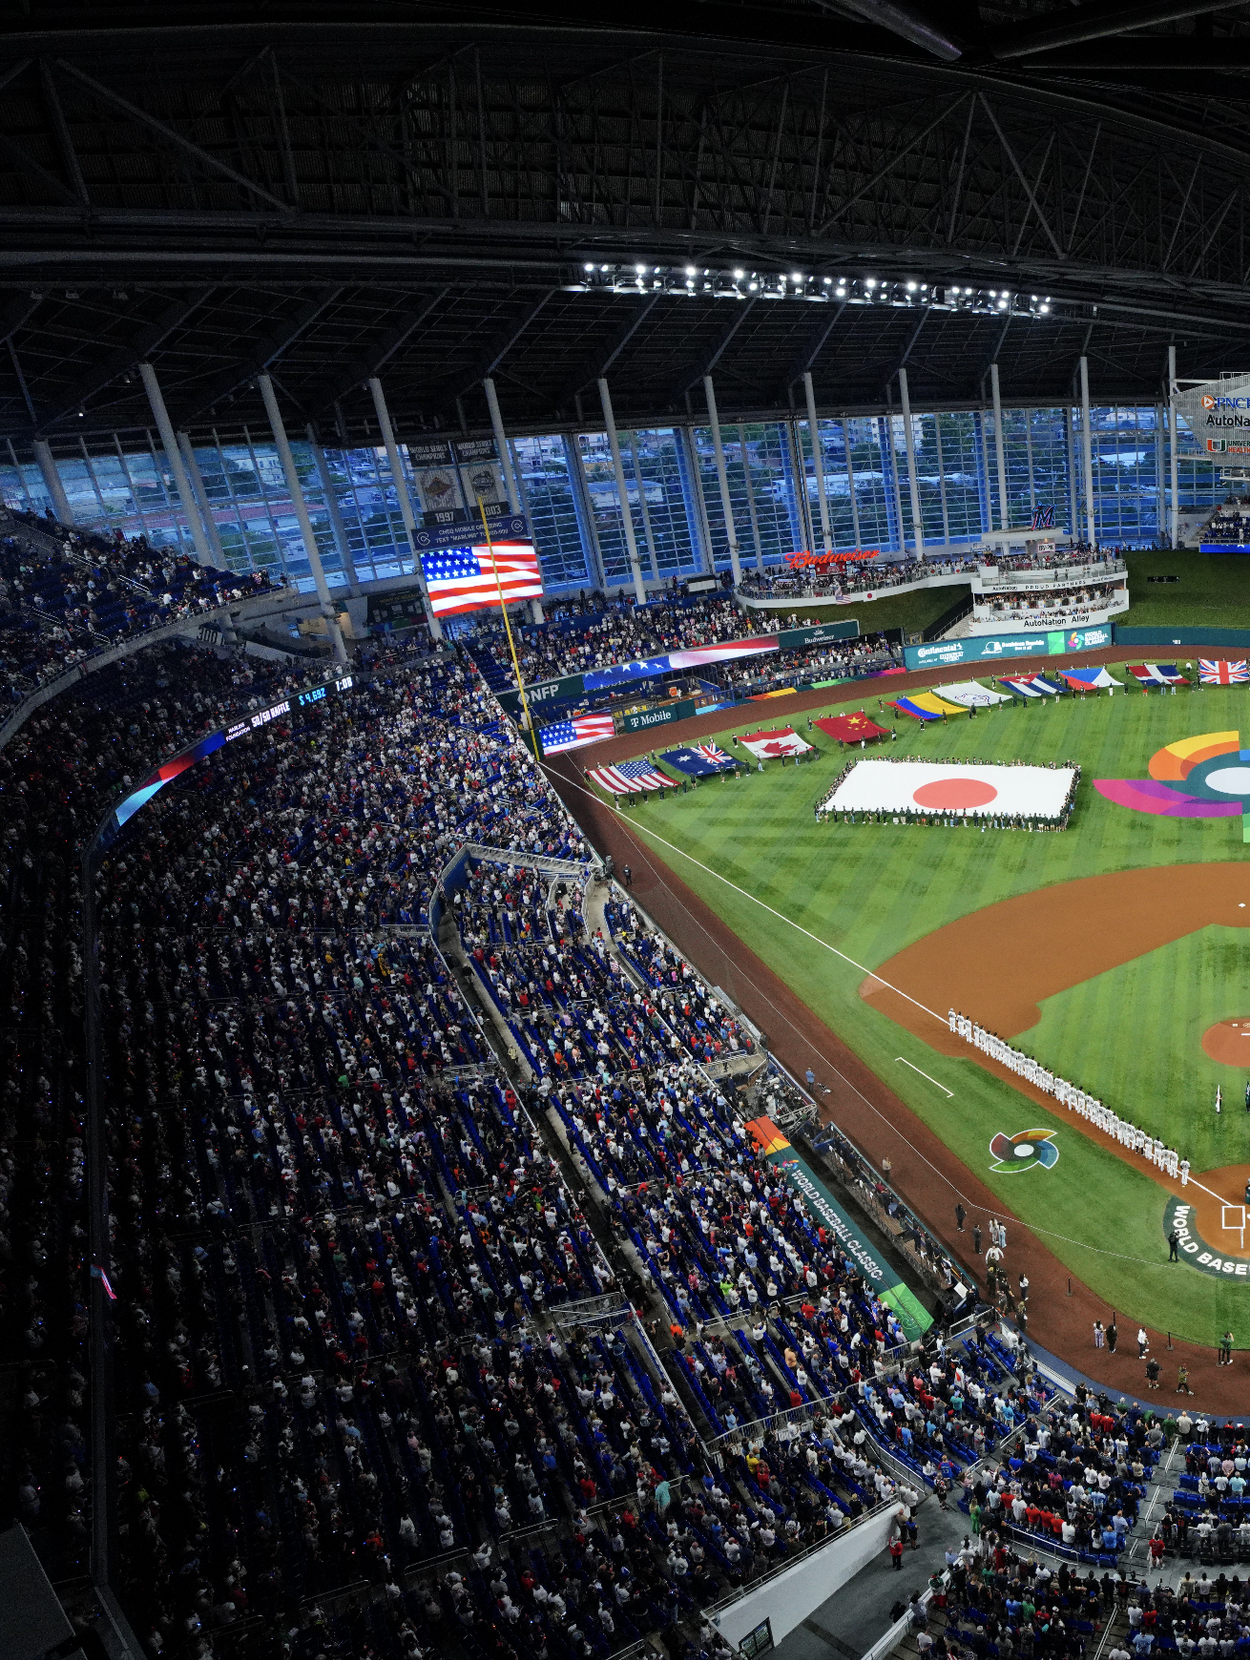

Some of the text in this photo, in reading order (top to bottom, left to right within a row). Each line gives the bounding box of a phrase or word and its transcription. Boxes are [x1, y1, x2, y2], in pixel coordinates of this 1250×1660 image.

[435, 511, 454, 522] 1997
[484, 505, 501, 515] 003
[785, 549, 879, 569] Budweiser
[1024, 614, 1089, 628] AutoNation Alley
[804, 634, 834, 643] Budweiser
[918, 644, 957, 657] Continental
[530, 685, 558, 702] NFP
[270, 701, 290, 718] RAFFLE
[641, 711, 671, 726] Mobile
[791, 1169, 884, 1280] WORLD BASEBALL CLASSIC
[1172, 1205, 1199, 1254] WORLD
